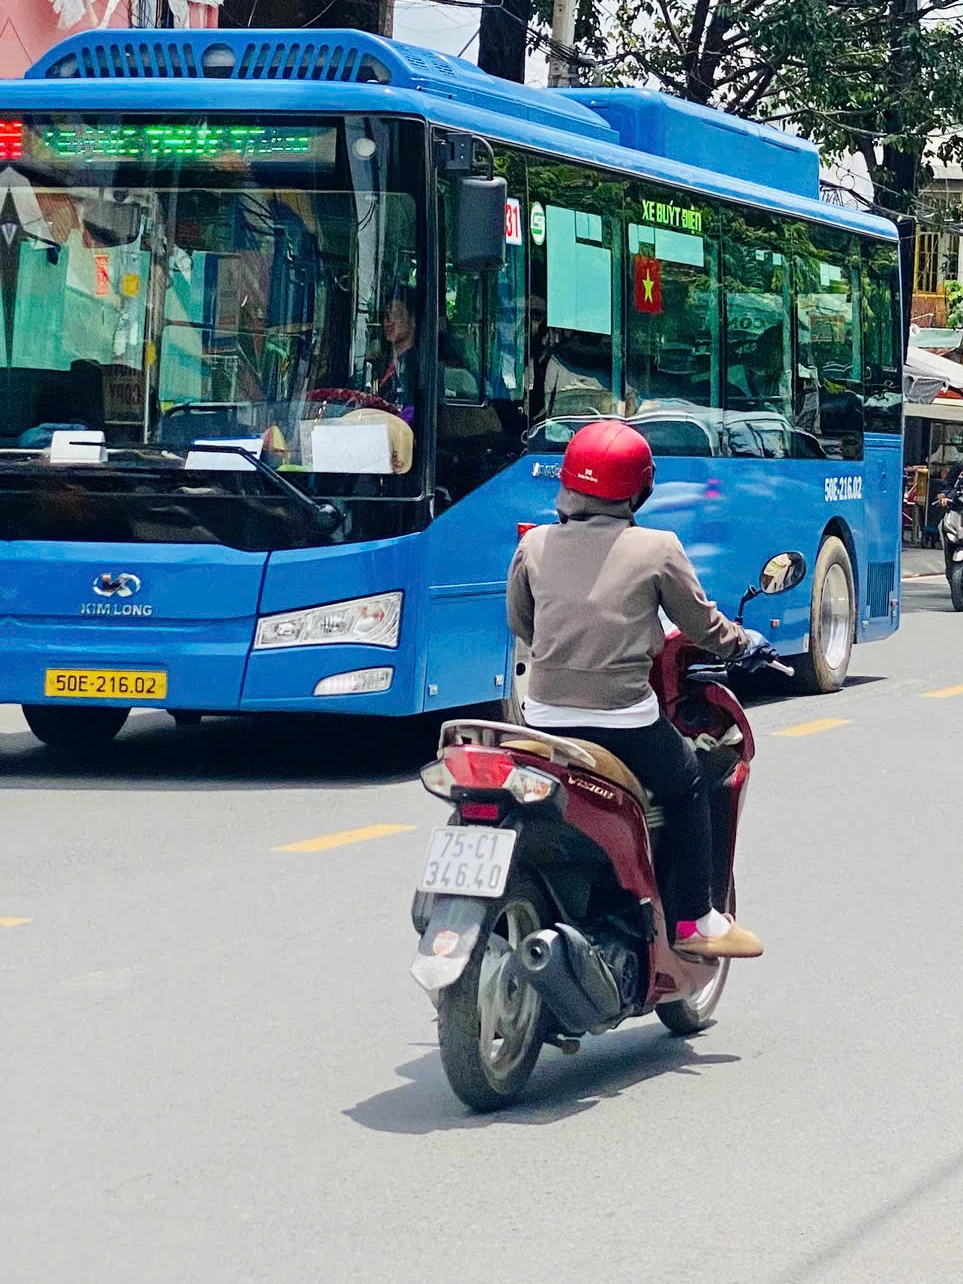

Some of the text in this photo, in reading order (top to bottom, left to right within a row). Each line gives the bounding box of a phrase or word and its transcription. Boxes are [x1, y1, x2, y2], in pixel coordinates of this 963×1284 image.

[642, 199, 655, 222] XE
[656, 200, 680, 227] BUÝT
[824, 475, 862, 502] 50E-216.02
[80, 603, 152, 616] KIM LONG
[56, 674, 157, 694] 50E-216.02
[440, 831, 499, 861] 75-C1
[425, 860, 502, 889] 346.40
